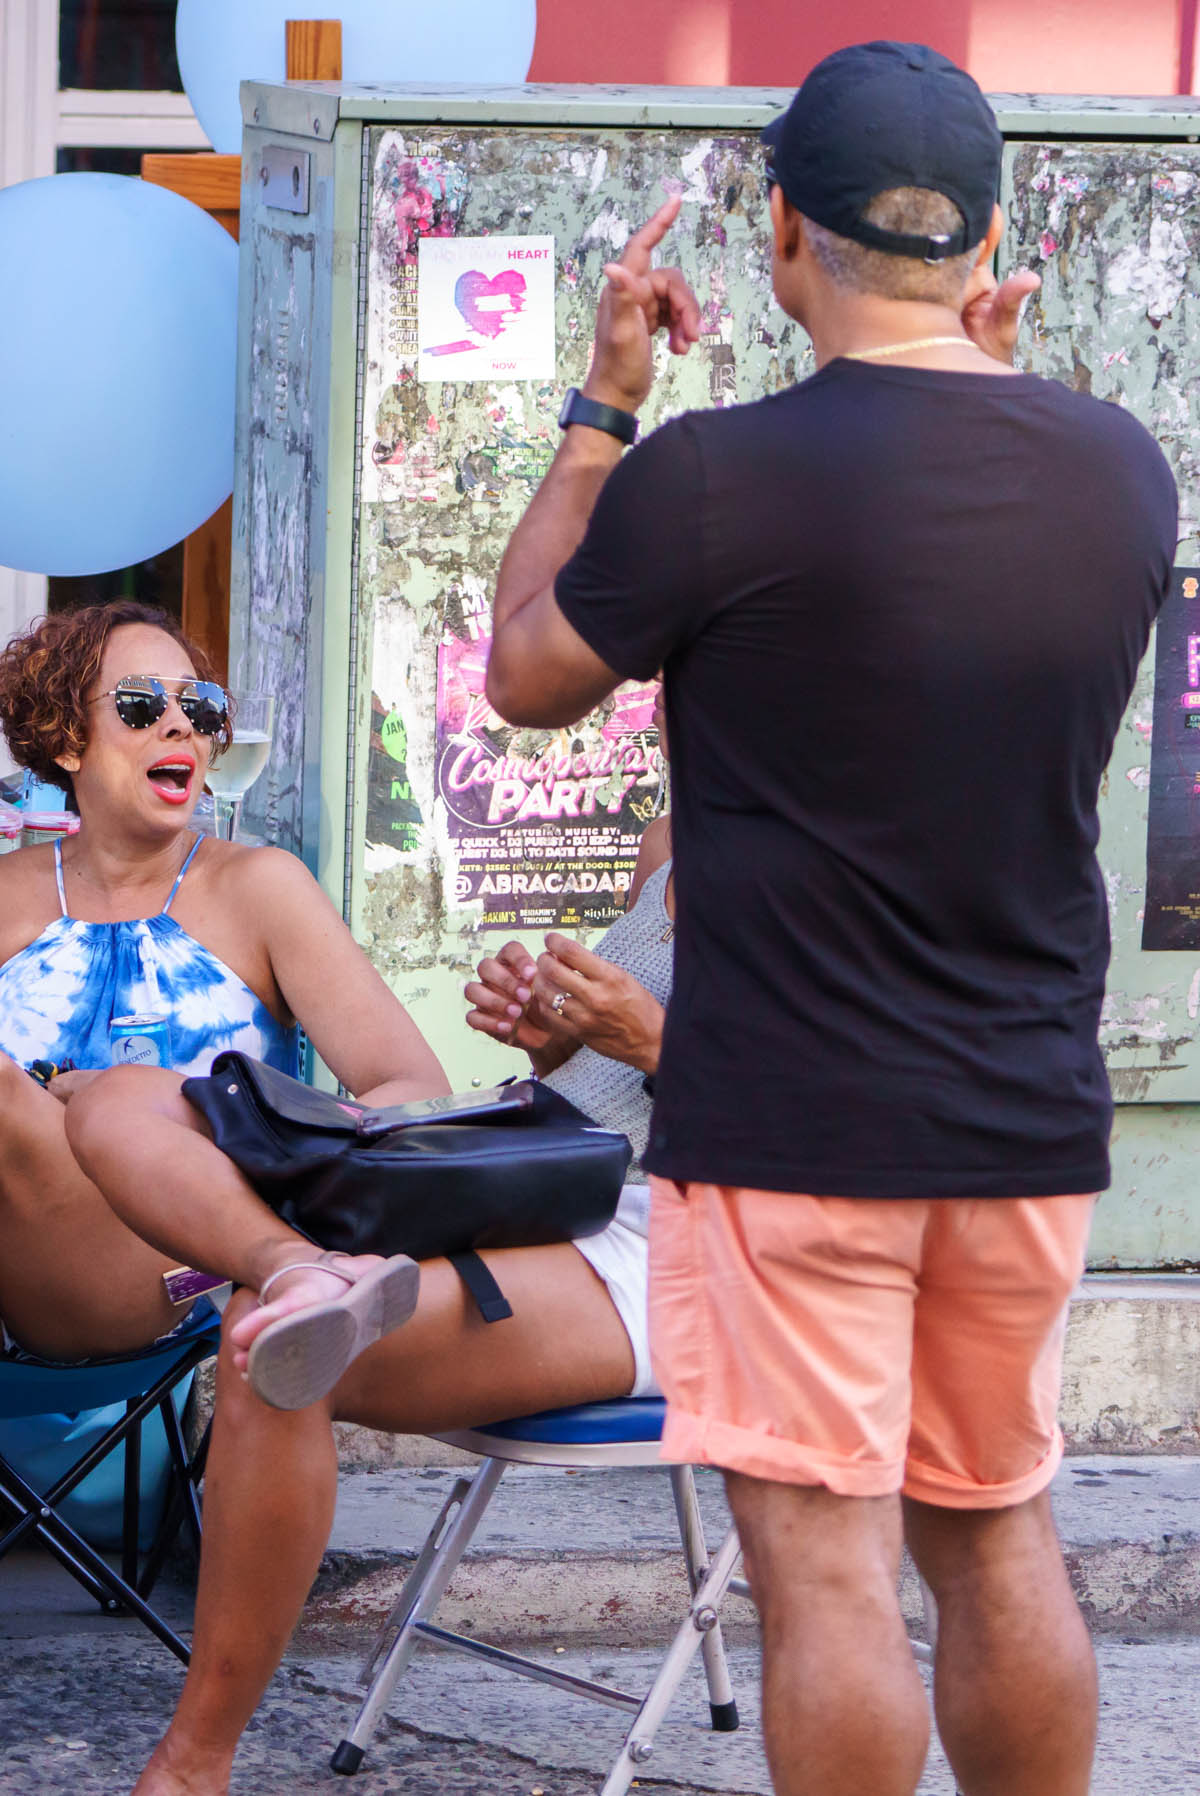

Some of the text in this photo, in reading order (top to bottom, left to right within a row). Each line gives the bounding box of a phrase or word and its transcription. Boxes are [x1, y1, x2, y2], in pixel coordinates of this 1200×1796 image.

[508, 249, 549, 260] HEART
[492, 362, 517, 370] NOW
[385, 720, 404, 736] JAN
[487, 774, 638, 823] PARTY
[565, 827, 599, 837] MUSIC
[602, 826, 620, 836] BY:
[544, 845, 576, 858] DATE
[576, 845, 618, 857] SOUND
[567, 861, 584, 871] THE
[477, 871, 635, 895] ABRACADAB
